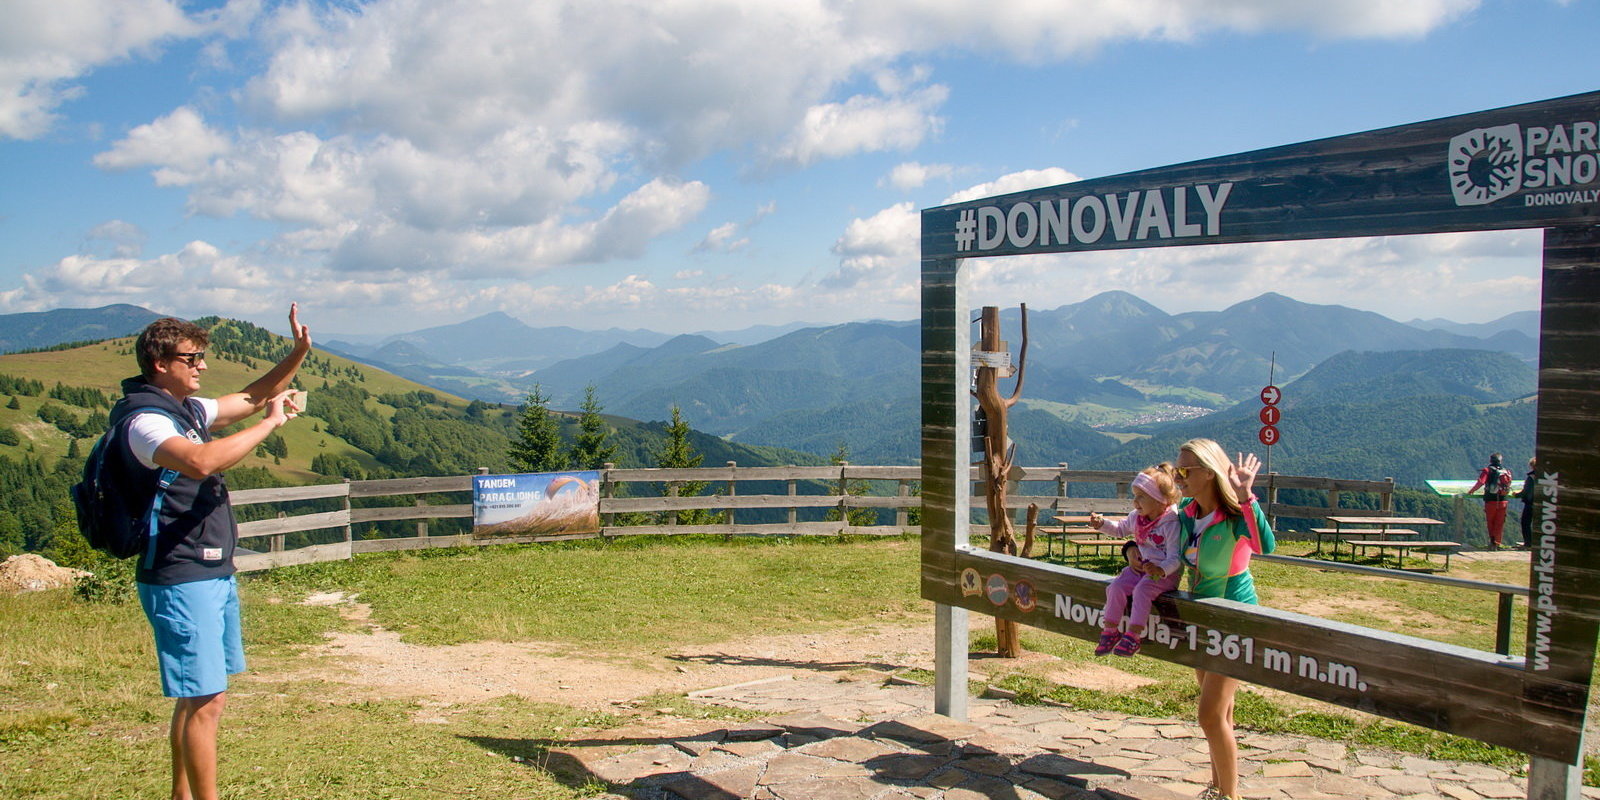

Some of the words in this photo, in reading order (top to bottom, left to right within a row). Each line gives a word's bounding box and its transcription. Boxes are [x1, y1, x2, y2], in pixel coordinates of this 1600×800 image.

[1526, 120, 1600, 156] PAR
[1523, 153, 1600, 188] SNO
[1525, 190, 1600, 207] DONOVALY
[955, 182, 1234, 252] #DONOVALY
[1265, 409, 1273, 423] 1
[1265, 429, 1275, 442] 9
[478, 478, 516, 489] TANDEM
[479, 491, 541, 503] PARAGLIDING
[1534, 471, 1559, 671] www.parksnow.sk
[1186, 625, 1197, 651] 1
[1206, 629, 1254, 665] 361
[1264, 646, 1292, 674] m
[1299, 655, 1368, 692] n.m.
